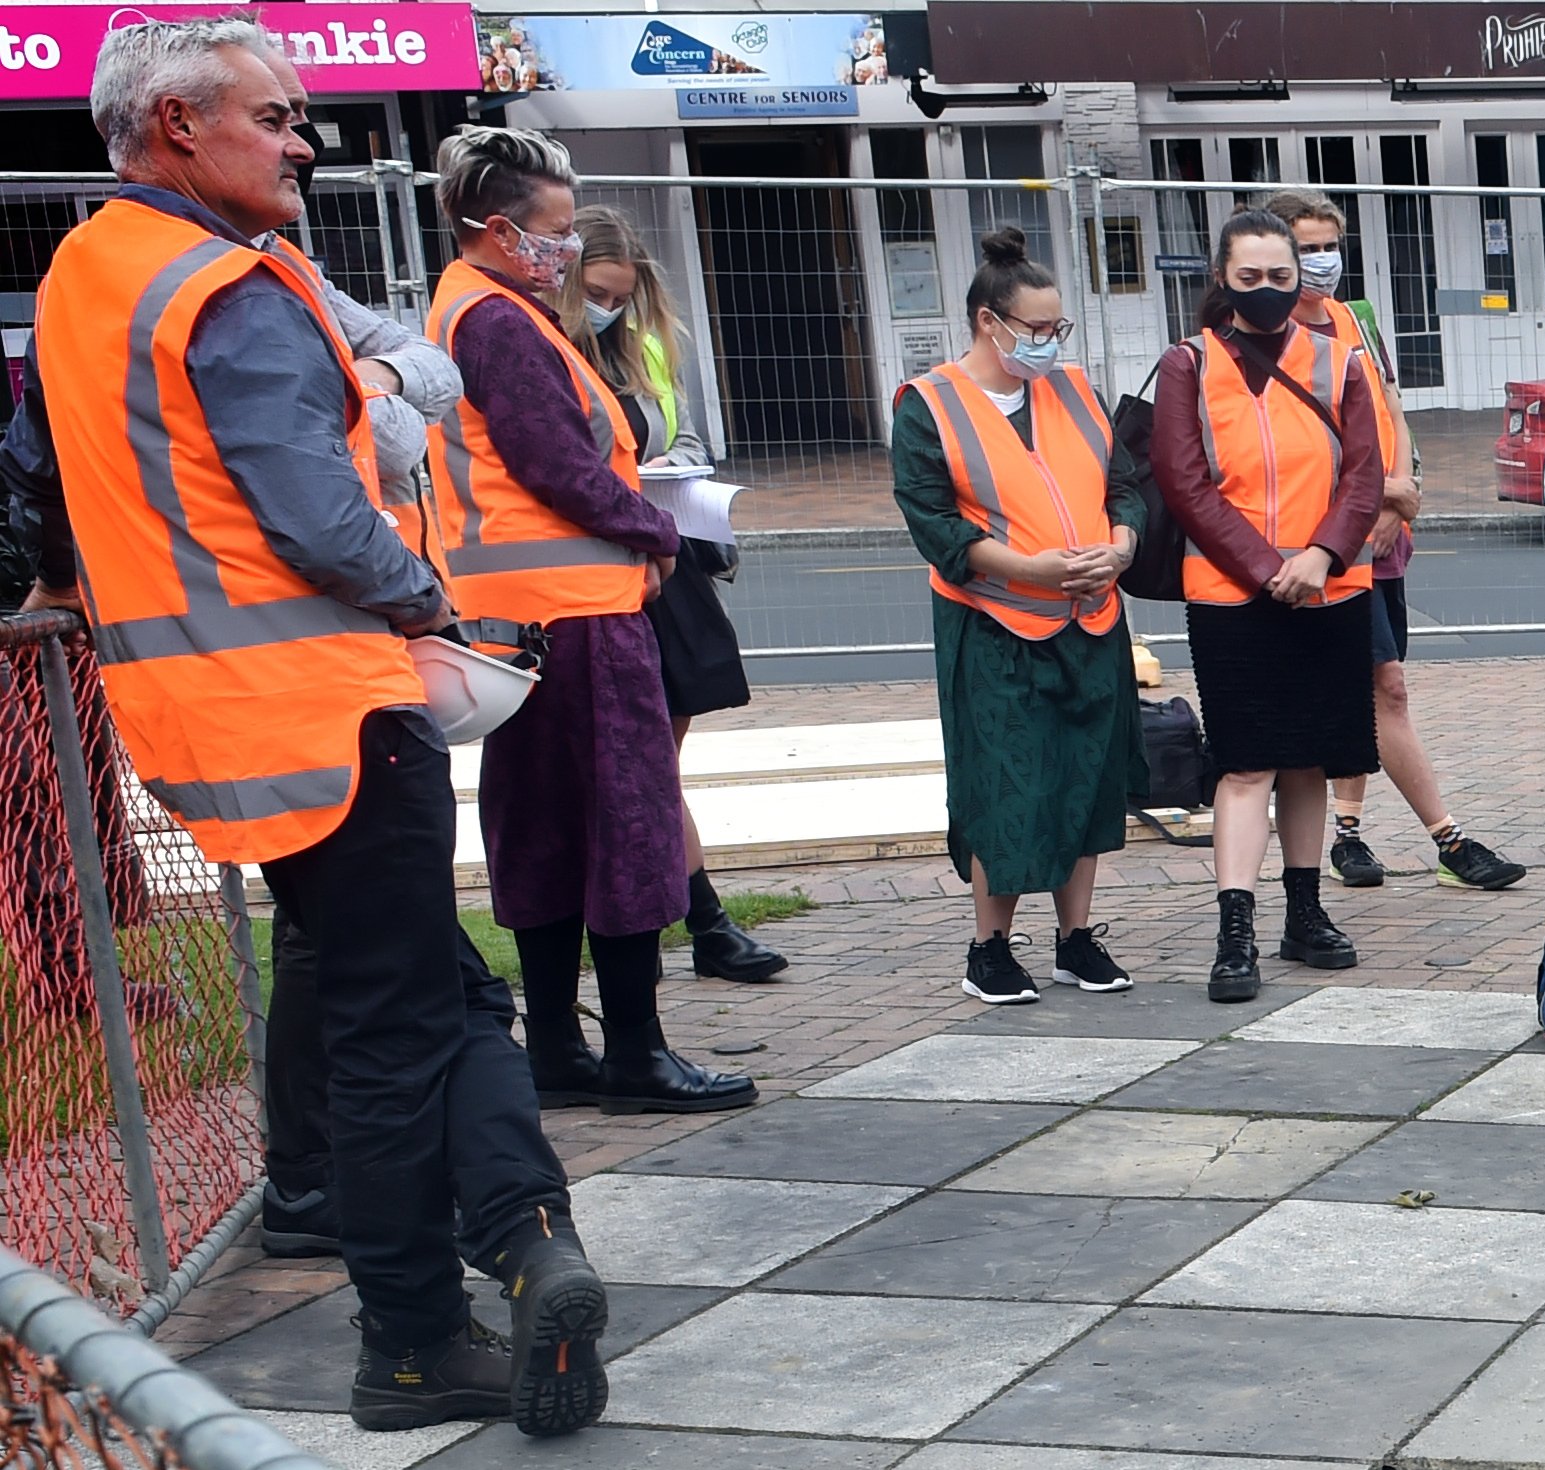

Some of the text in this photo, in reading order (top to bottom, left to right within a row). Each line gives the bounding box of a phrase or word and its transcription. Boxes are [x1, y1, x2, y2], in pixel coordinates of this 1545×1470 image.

[649, 49, 705, 64] Concern
[687, 91, 847, 104] CENTRE FOR SENIORS
